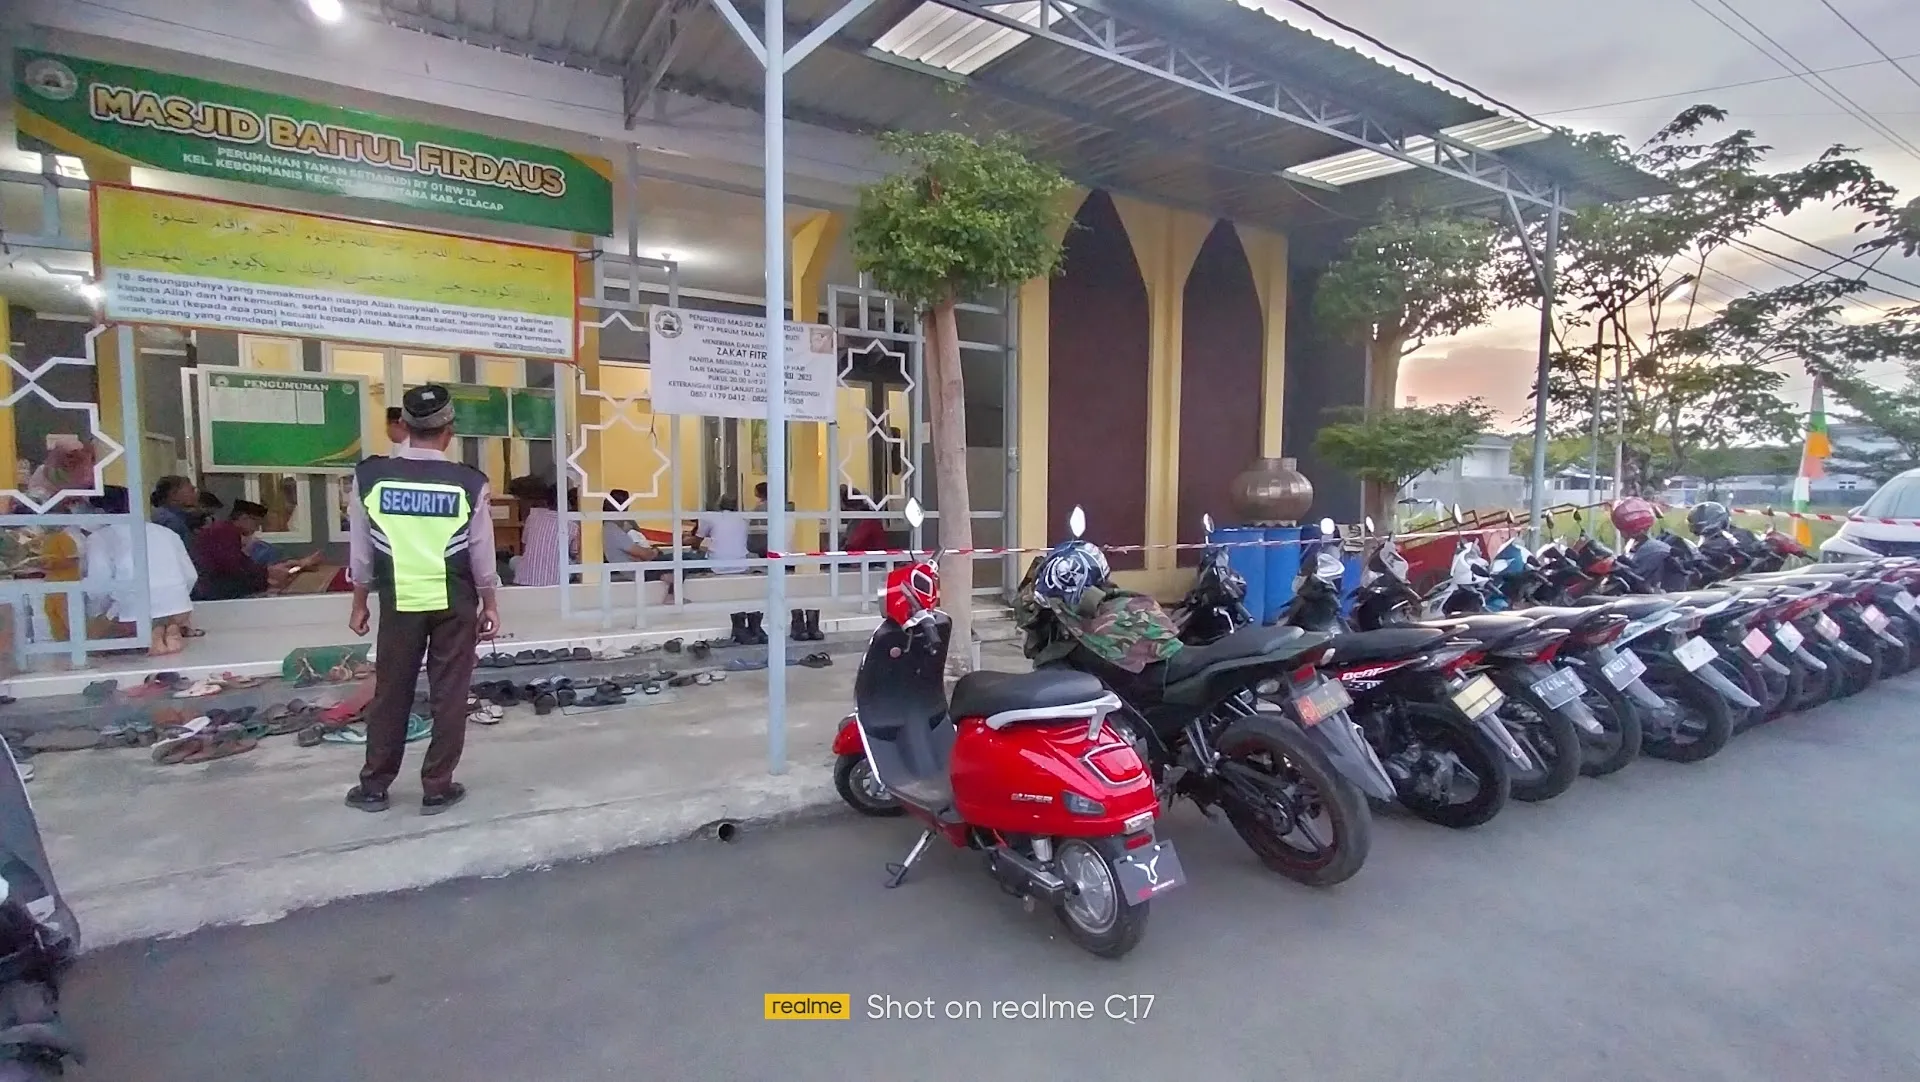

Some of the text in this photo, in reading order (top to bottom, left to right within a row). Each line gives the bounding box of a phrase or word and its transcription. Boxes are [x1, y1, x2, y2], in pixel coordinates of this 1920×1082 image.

[92, 85, 564, 196] MASJID BAITUL FIRDAUS
[217, 146, 299, 168] PERUMAHAN
[303, 160, 347, 175] TAMAN
[414, 180, 428, 189] RT
[431, 182, 443, 191] 01
[445, 184, 463, 194] RW
[466, 188, 477, 197] 12
[183, 153, 213, 166] KEL.
[216, 158, 302, 180] KEBONMANIS
[305, 172, 333, 185] KEC.
[430, 193, 456, 204] KAB.
[458, 197, 504, 211] CILACAP
[138, 274, 223, 291] Sesungguhnya
[226, 284, 253, 295] yang
[256, 289, 332, 302] memakmurkan
[371, 300, 395, 309] Allah
[398, 302, 440, 314] hanyalah
[441, 309, 496, 321] orang-orang
[497, 314, 518, 323] yang
[117, 284, 160, 295] kepada
[163, 288, 192, 297] Allah
[196, 291, 217, 300] dan
[220, 294, 241, 302] hari
[330, 305, 362, 316] (tetap)
[364, 310, 431, 322] melaksanakan
[514, 323, 536, 333] zakat
[151, 297, 179, 306] takut
[183, 300, 227, 311] (kepada
[253, 307, 277, 317] pun)
[388, 321, 413, 330] Maka
[194, 311, 221, 321] yang
[224, 314, 278, 326] mendapat
[689, 313, 726, 325] PENGURUS
[727, 319, 753, 328] MASJID
[716, 327, 739, 336] PERUM
[741, 329, 765, 338] TAMAN
[702, 338, 735, 348] MENERIMA
[737, 341, 750, 349] DAN
[717, 346, 746, 358] ZAKAT
[749, 350, 768, 360] FITR
[690, 365, 705, 373] DARI
[707, 366, 738, 375] TANGGAL
[751, 361, 767, 369] ZAKA
[243, 378, 329, 392] PENGUMUMAN
[668, 380, 712, 390] KETERANGAN
[381, 489, 458, 515] SECURITY
